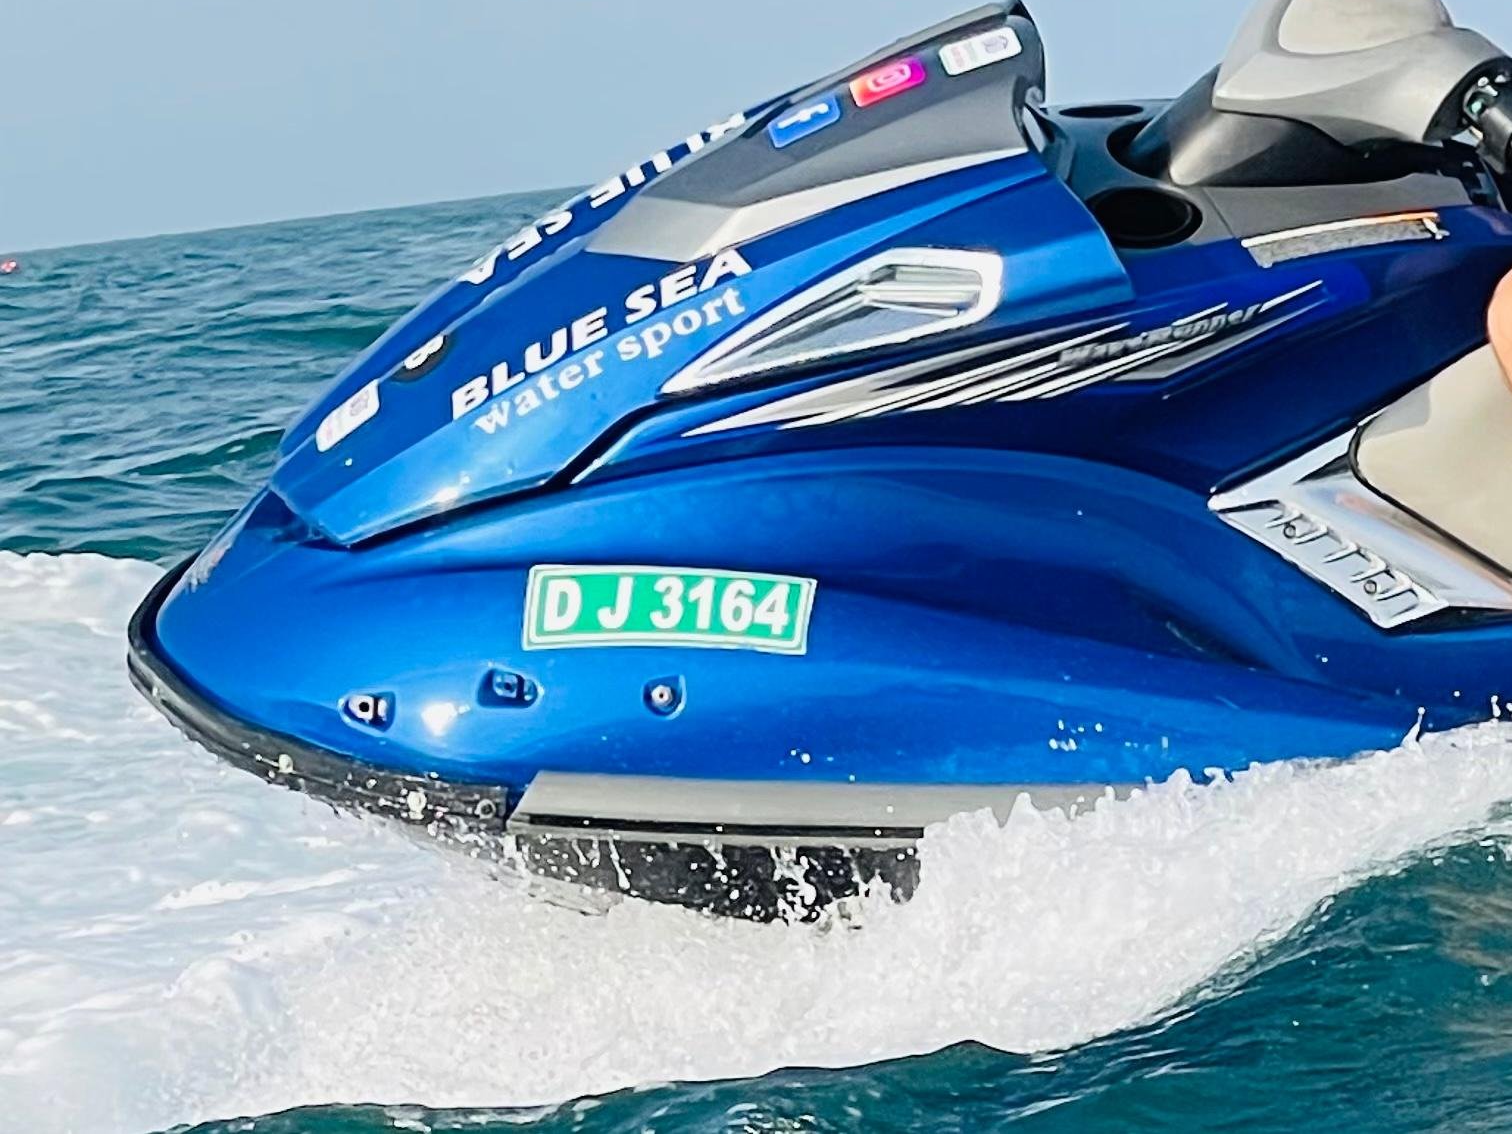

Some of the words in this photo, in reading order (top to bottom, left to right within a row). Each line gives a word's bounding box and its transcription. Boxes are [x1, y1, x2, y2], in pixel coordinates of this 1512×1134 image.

[451, 306, 609, 422] BLUE
[624, 248, 753, 326] SEA
[474, 348, 605, 436] water
[616, 286, 747, 360] sport
[649, 575, 791, 636] 3164
